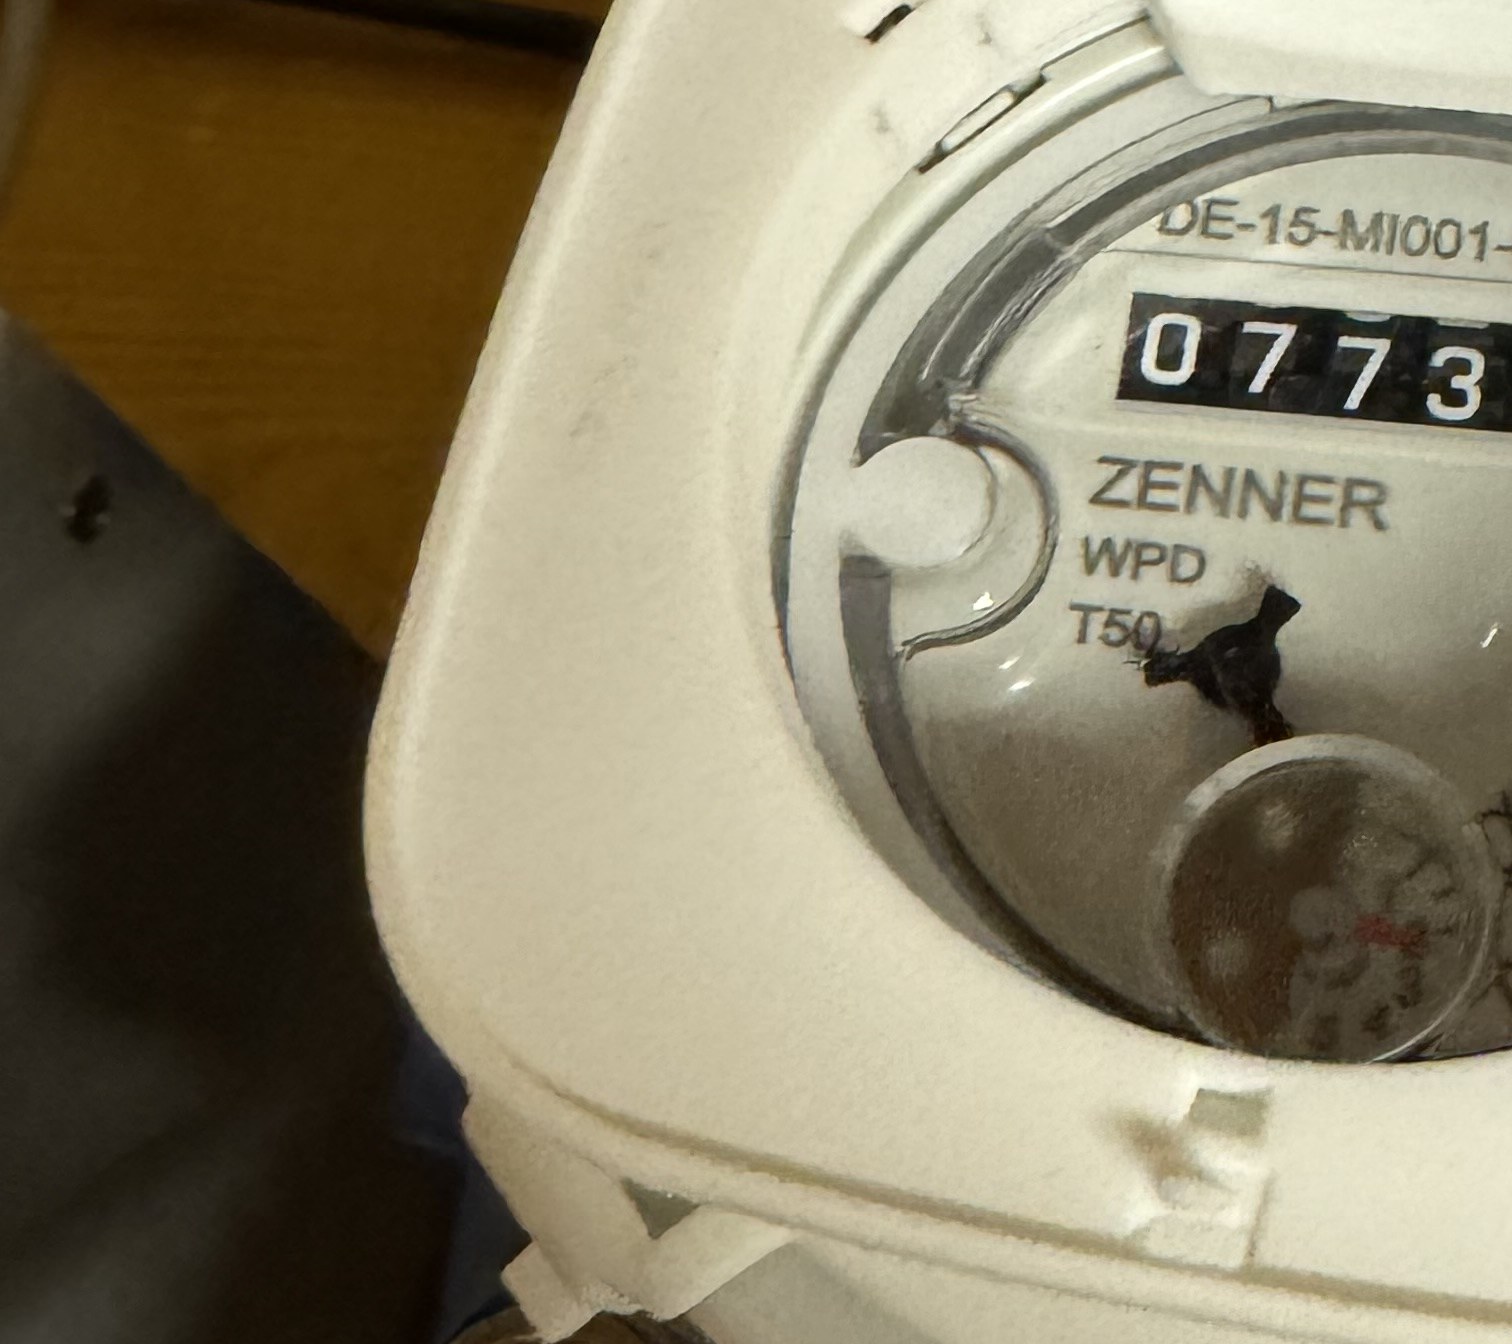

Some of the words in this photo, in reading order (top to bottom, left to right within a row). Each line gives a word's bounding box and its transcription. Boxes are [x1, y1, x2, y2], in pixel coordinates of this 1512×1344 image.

[1088, 455, 1389, 532] ZENNER
[1081, 535, 1207, 583] WPD
[1068, 600, 1163, 657] T50
